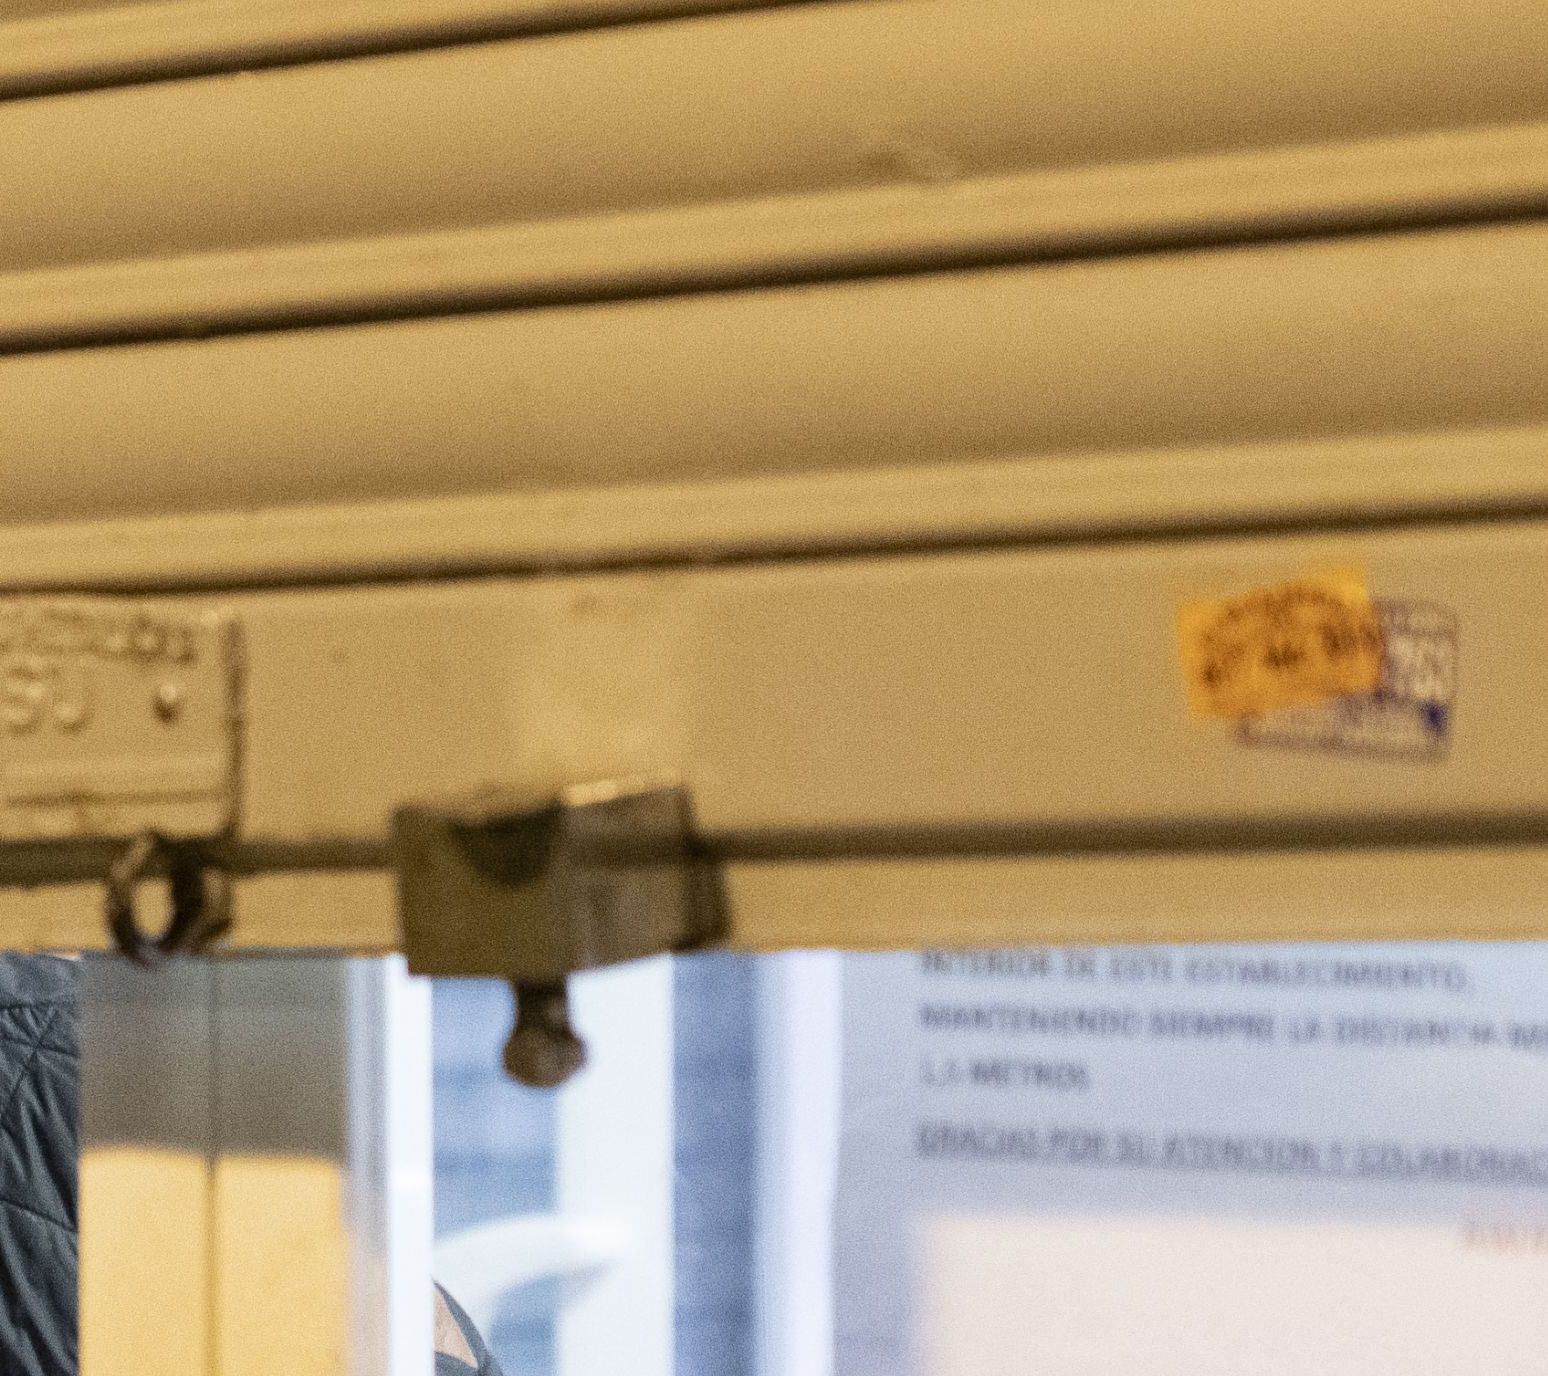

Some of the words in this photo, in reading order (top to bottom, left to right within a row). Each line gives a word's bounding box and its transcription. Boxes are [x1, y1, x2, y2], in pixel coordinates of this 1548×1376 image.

[1149, 1009, 1277, 1041] SIEMPRE
[916, 1123, 1039, 1160] GRACIAS
[1047, 1127, 1104, 1164] POR
